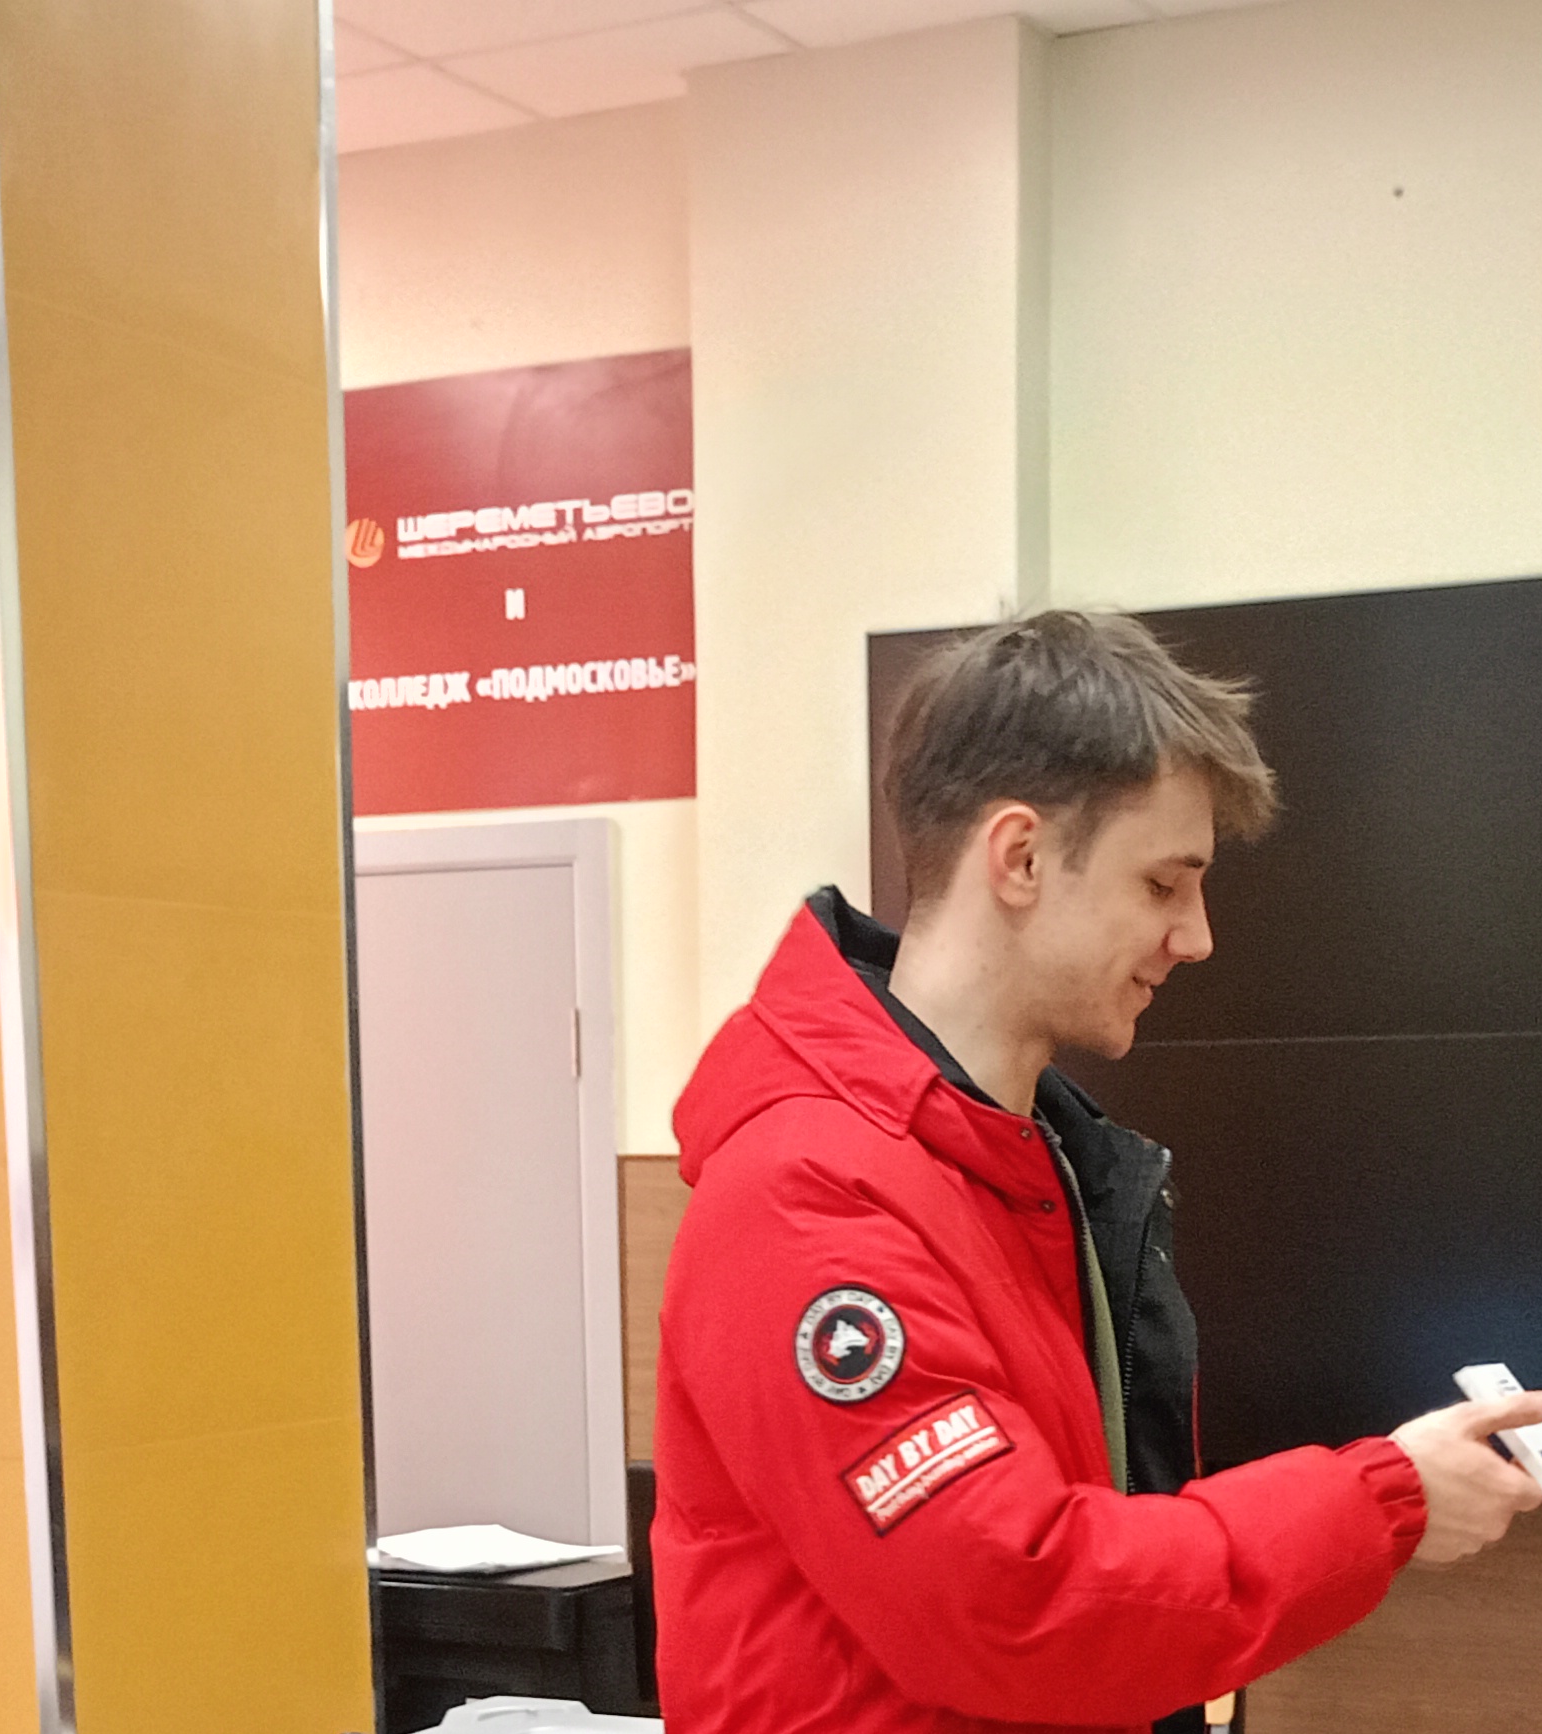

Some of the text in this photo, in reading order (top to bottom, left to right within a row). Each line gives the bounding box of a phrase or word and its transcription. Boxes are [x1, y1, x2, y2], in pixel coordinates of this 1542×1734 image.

[397, 489, 694, 542] ШЕРЕМЕТЬЕВО
[347, 655, 696, 710] КОЛЛЕДЖ «ПОДМОСКОВЬЕ»
[855, 1454, 900, 1501] DAY
[897, 1430, 933, 1469] BY
[932, 1405, 981, 1446] DAY
